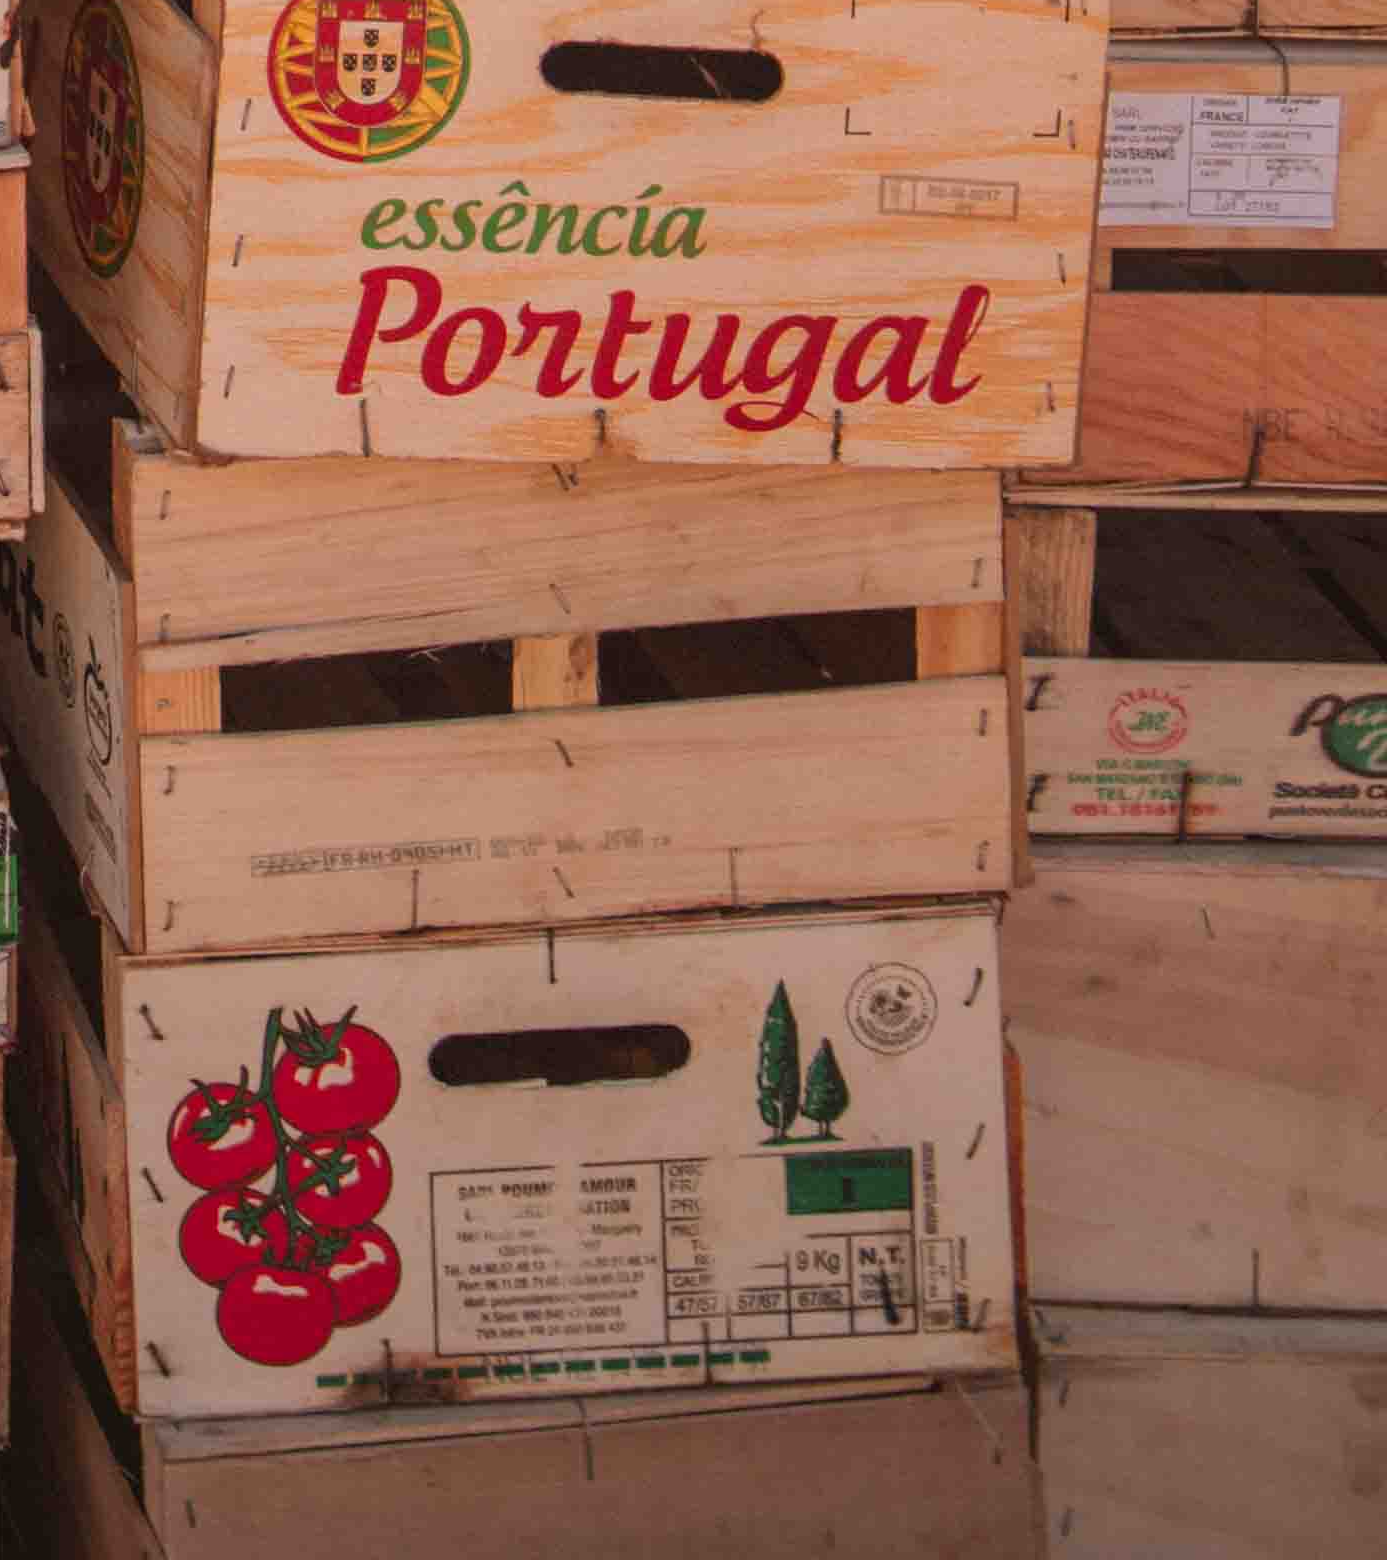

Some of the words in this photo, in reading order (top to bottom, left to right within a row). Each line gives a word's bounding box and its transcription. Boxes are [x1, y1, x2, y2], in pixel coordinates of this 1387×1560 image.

[1200, 110, 1245, 123] FRANCE
[335, 265, 990, 432] Portugal
[795, 1249, 810, 1271] 9
[813, 1250, 842, 1274] Kg
[858, 1246, 907, 1266] N.T.
